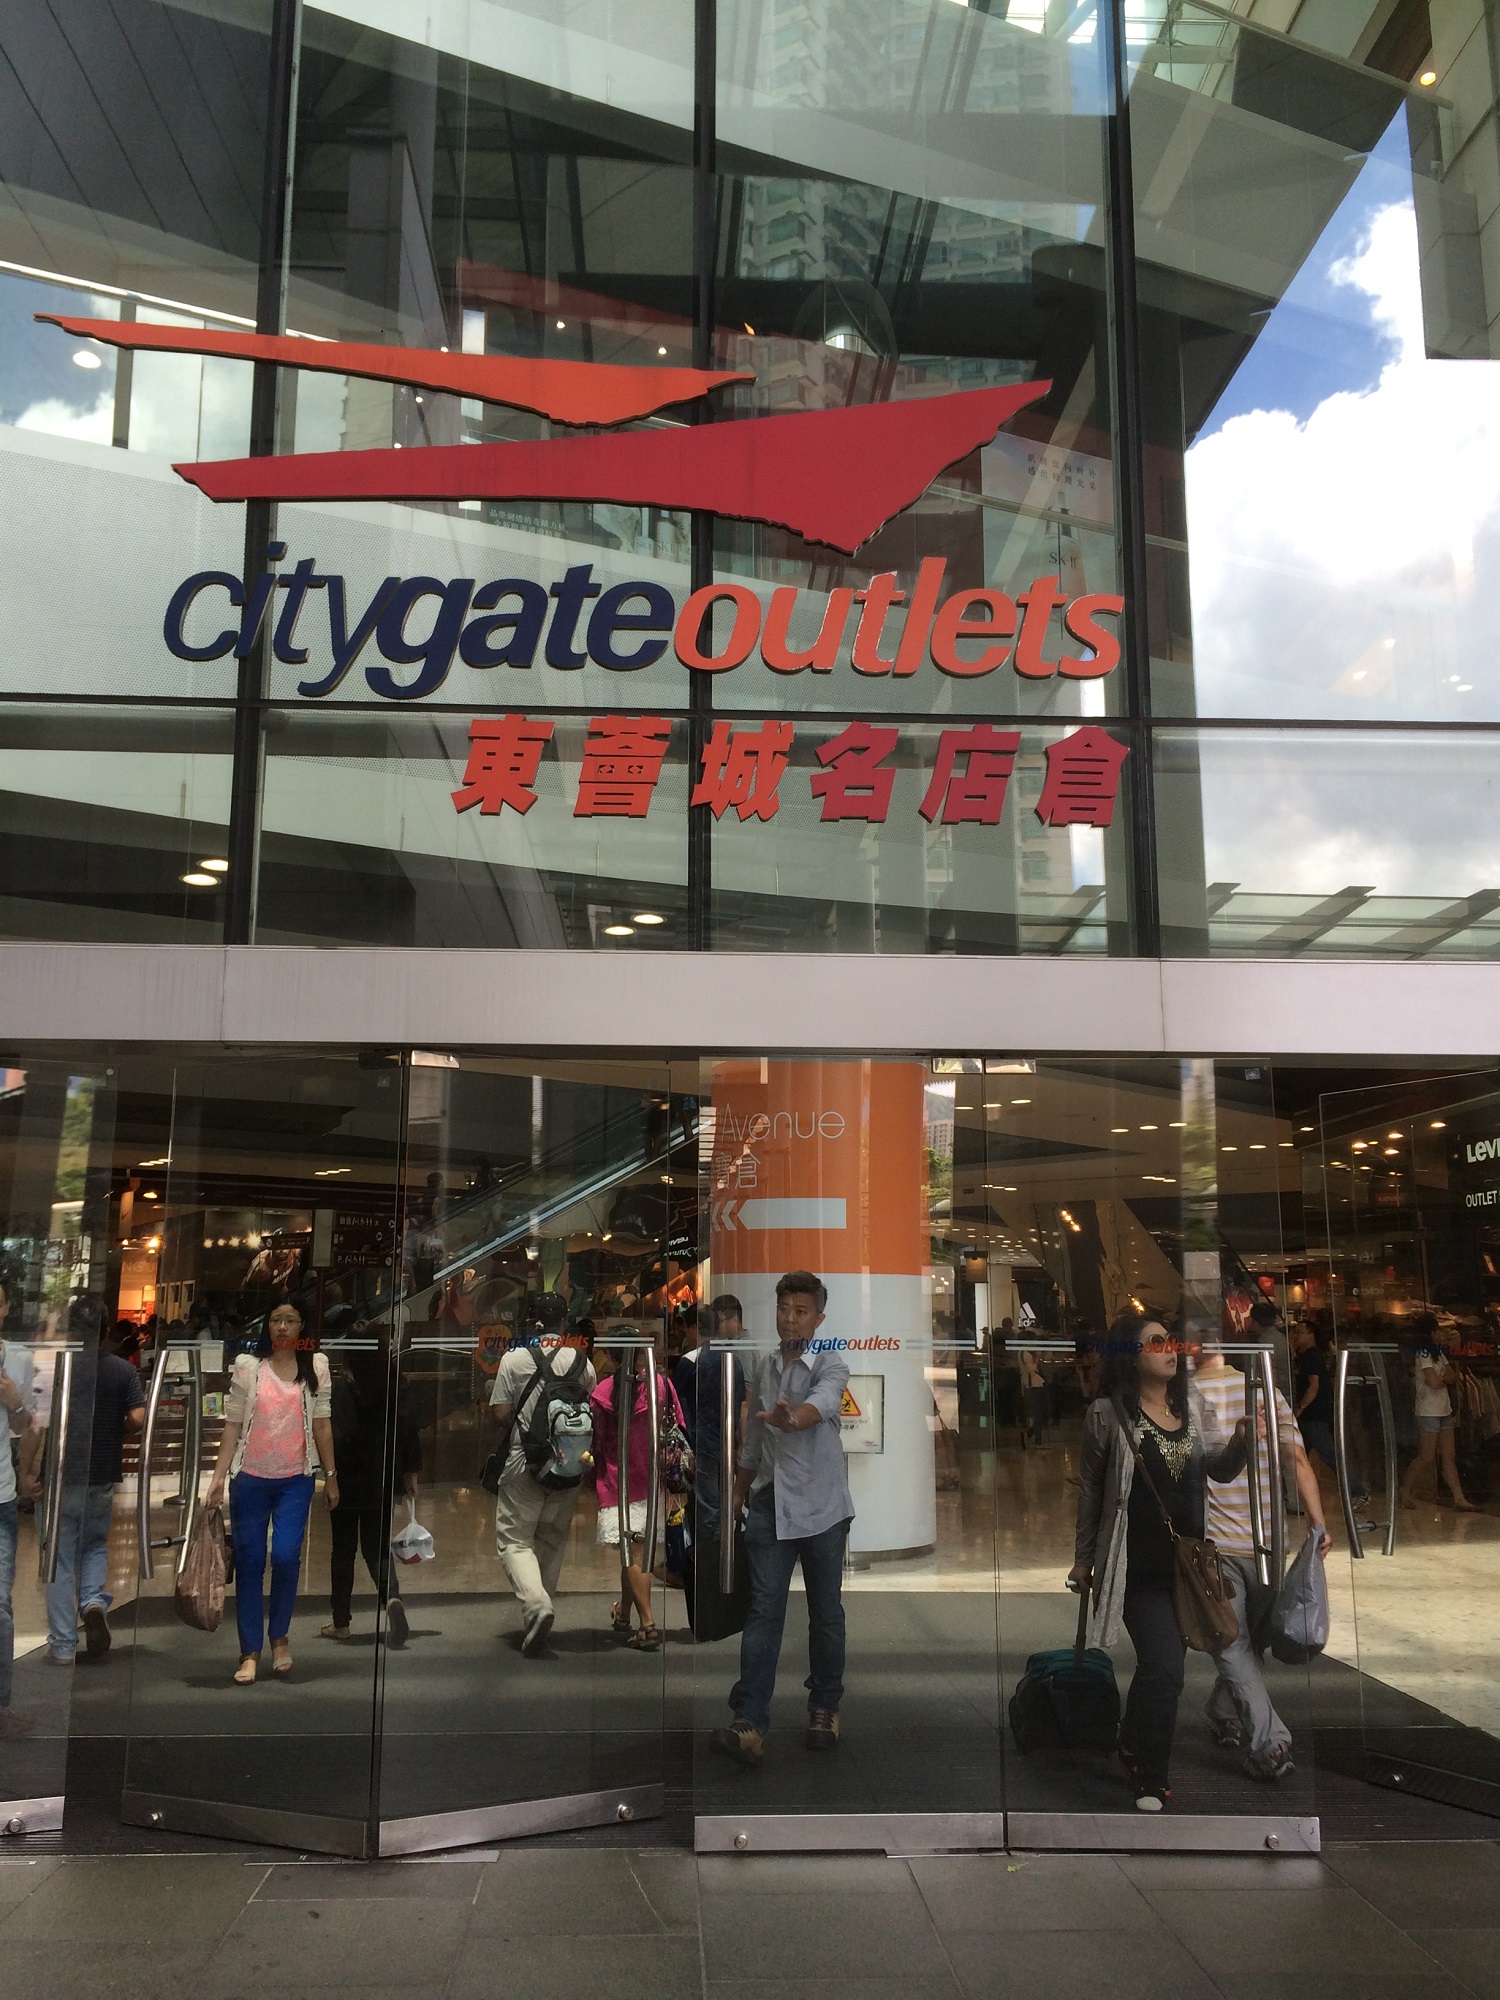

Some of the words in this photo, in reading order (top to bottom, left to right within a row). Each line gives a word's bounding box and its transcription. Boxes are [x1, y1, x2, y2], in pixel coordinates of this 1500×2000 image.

[451, 713, 1130, 828] 東薈城名店倉
[721, 1103, 845, 1142] Avenue
[1465, 1190, 1497, 1208] OUTLET
